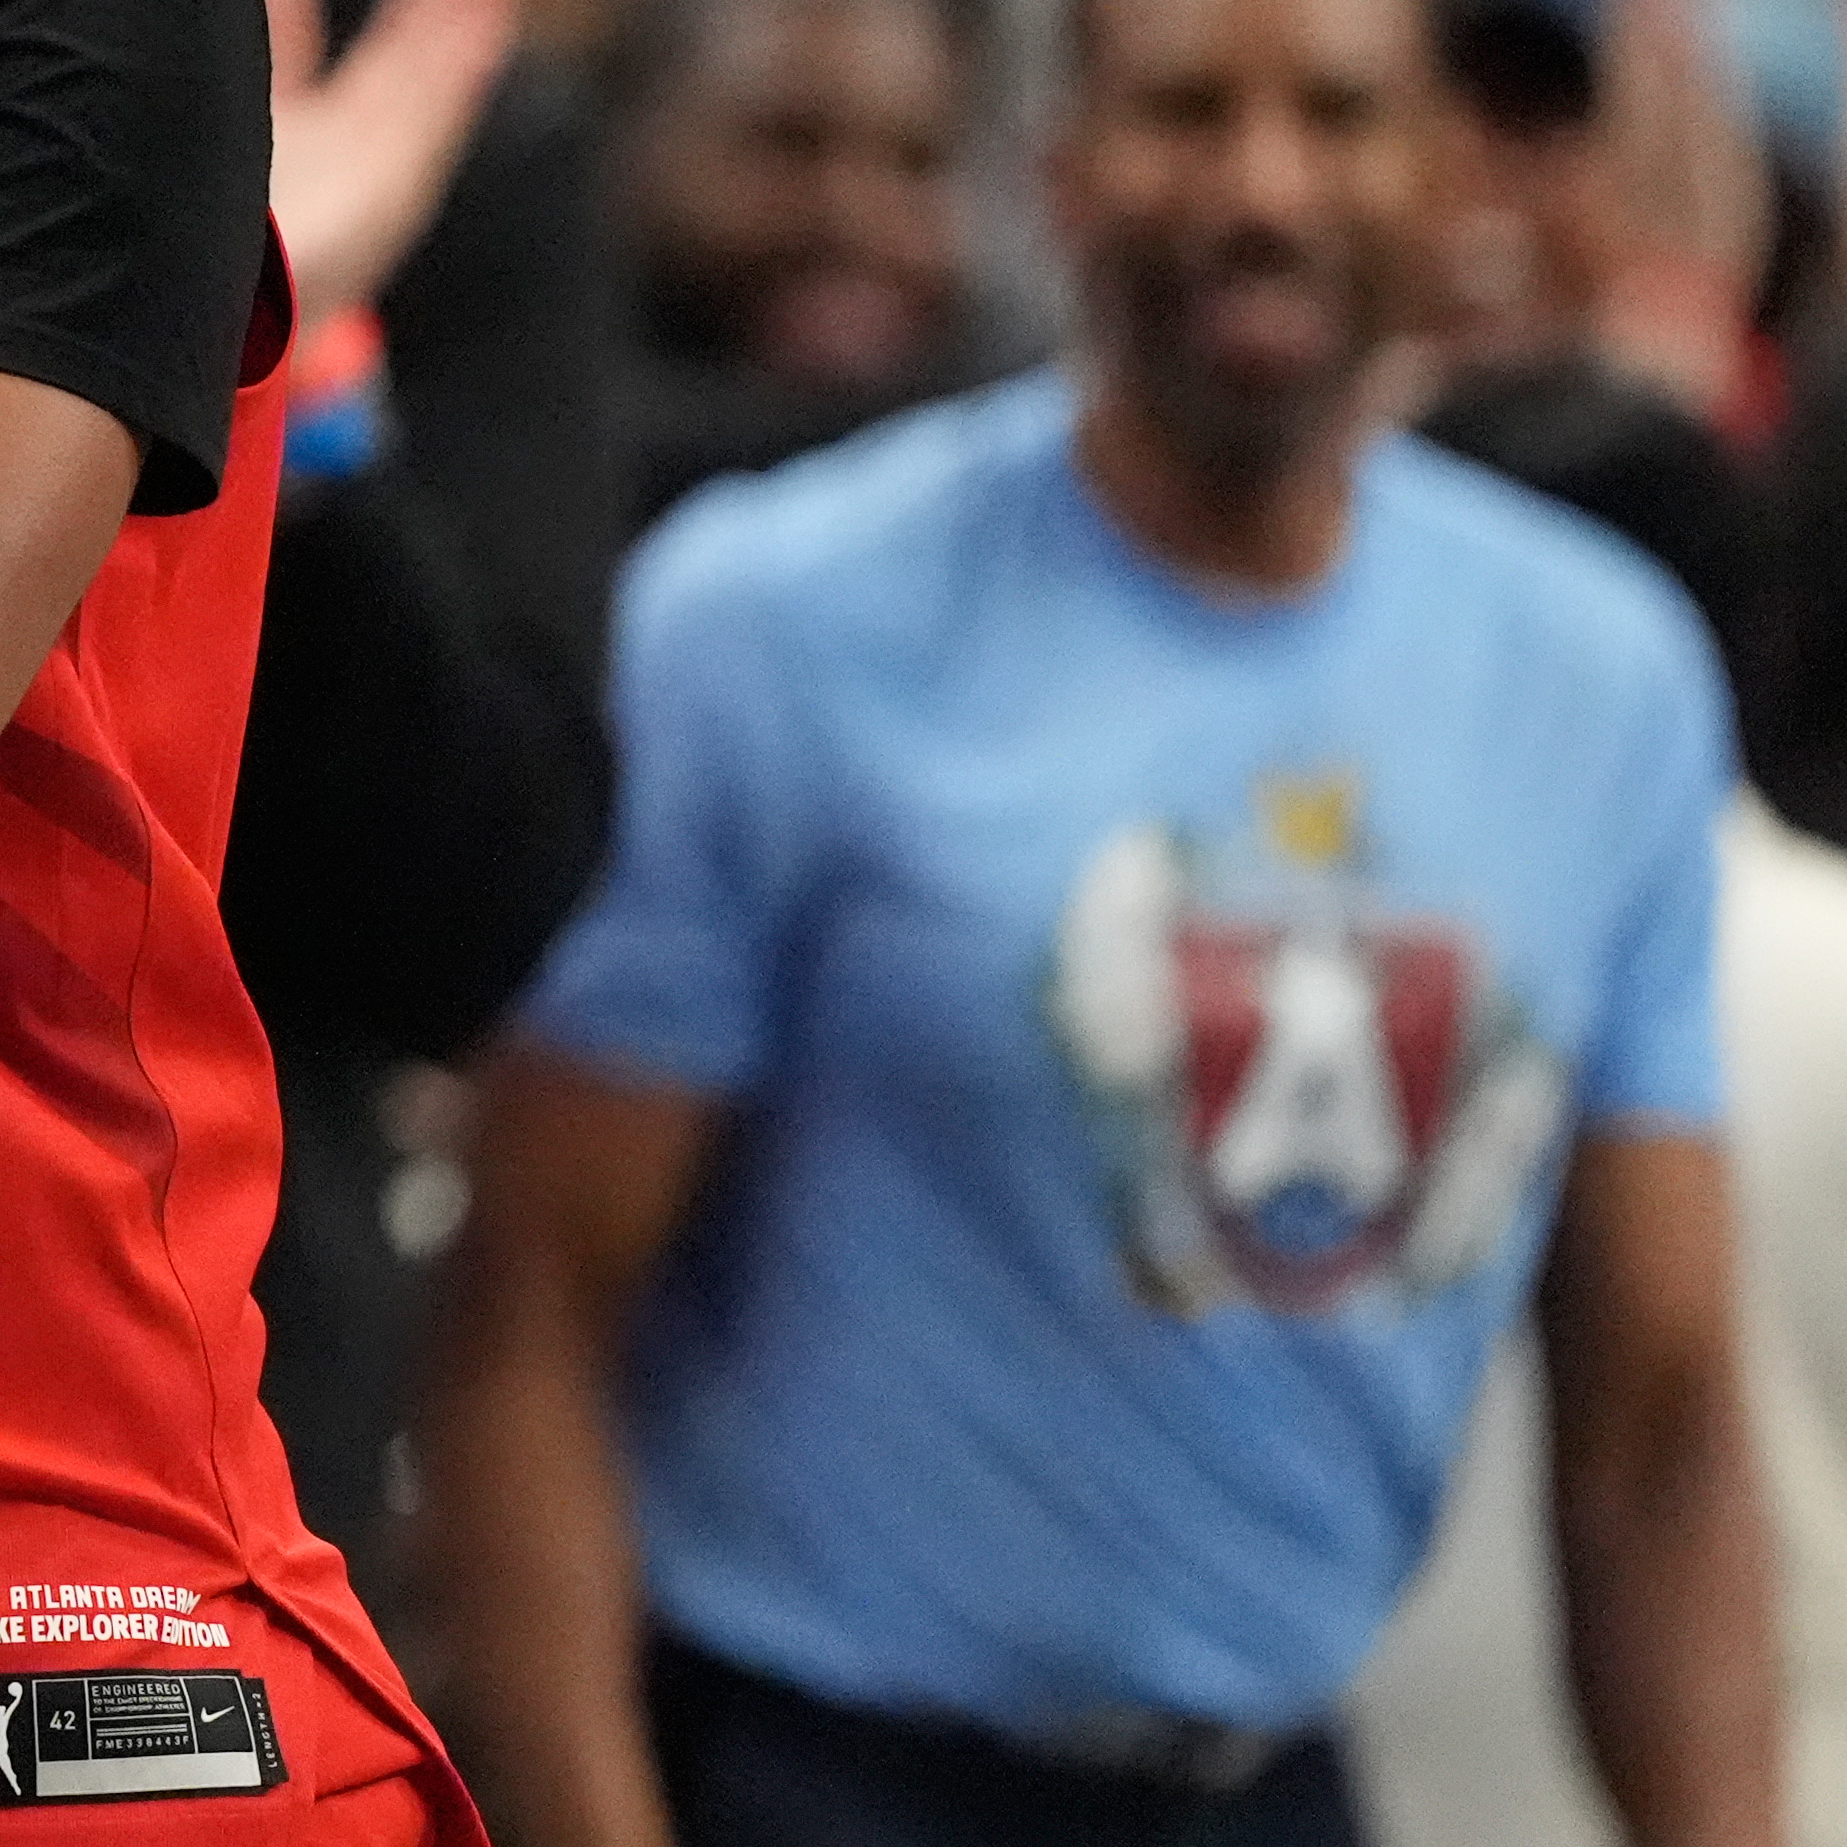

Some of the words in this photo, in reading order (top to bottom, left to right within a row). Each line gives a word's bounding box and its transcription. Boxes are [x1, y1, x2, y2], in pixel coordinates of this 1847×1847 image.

[9, 1584, 125, 1610] ATLANTA
[129, 1585, 202, 1616] DREAM
[30, 1613, 159, 1643] EXPLORER
[160, 1615, 231, 1648] EDITION
[91, 1683, 181, 1697] ENGINEERED
[49, 1710, 76, 1730] 42
